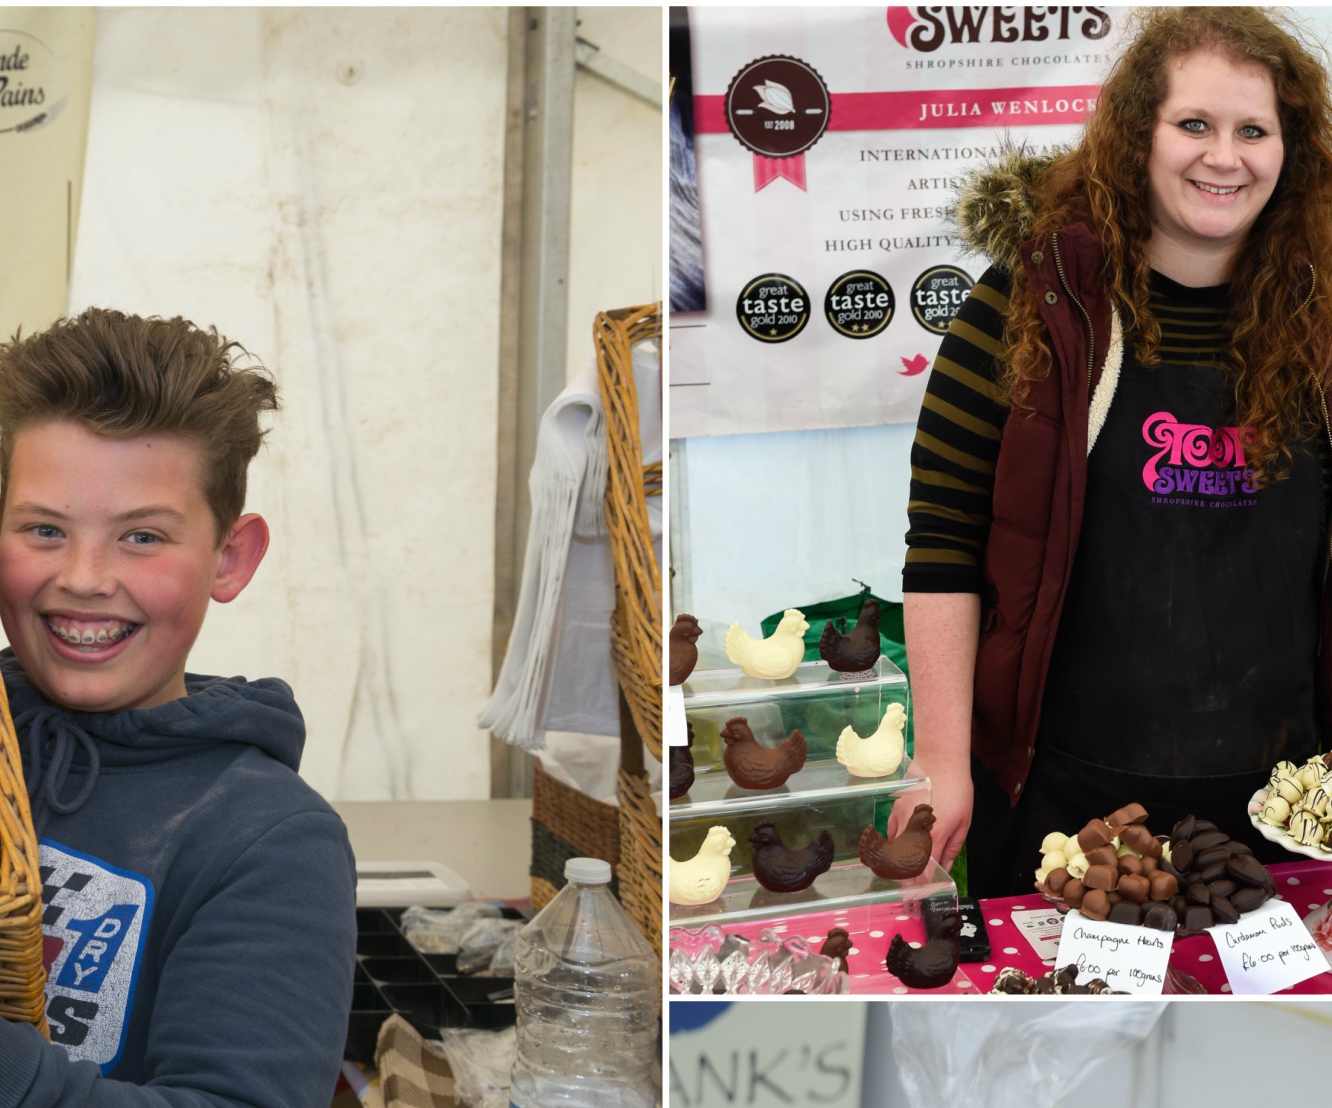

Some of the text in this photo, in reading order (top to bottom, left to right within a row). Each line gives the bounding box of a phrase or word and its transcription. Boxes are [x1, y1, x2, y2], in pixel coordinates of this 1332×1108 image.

[905, 54, 1111, 69] SHROPSHIRE CHOCOLATES
[919, 102, 982, 121] JULIA
[774, 120, 795, 130] 2008
[839, 209, 894, 222] USING
[825, 235, 952, 251] HIGH QUALITY
[758, 286, 788, 298] great
[846, 282, 874, 294] great
[742, 295, 804, 314] taste
[830, 291, 889, 310] taste
[750, 312, 797, 326] gold 2010
[837, 308, 883, 323] gold 2010
[1154, 466, 1258, 496] SWEETS
[1151, 496, 1257, 509] SHROPSHIRE CHOCOLATES
[1269, 916, 1293, 930] Pods
[1073, 927, 1164, 952] Champagne Hearts
[74, 918, 121, 985] DRY
[1278, 949, 1290, 965] per
[1105, 968, 1121, 984] per
